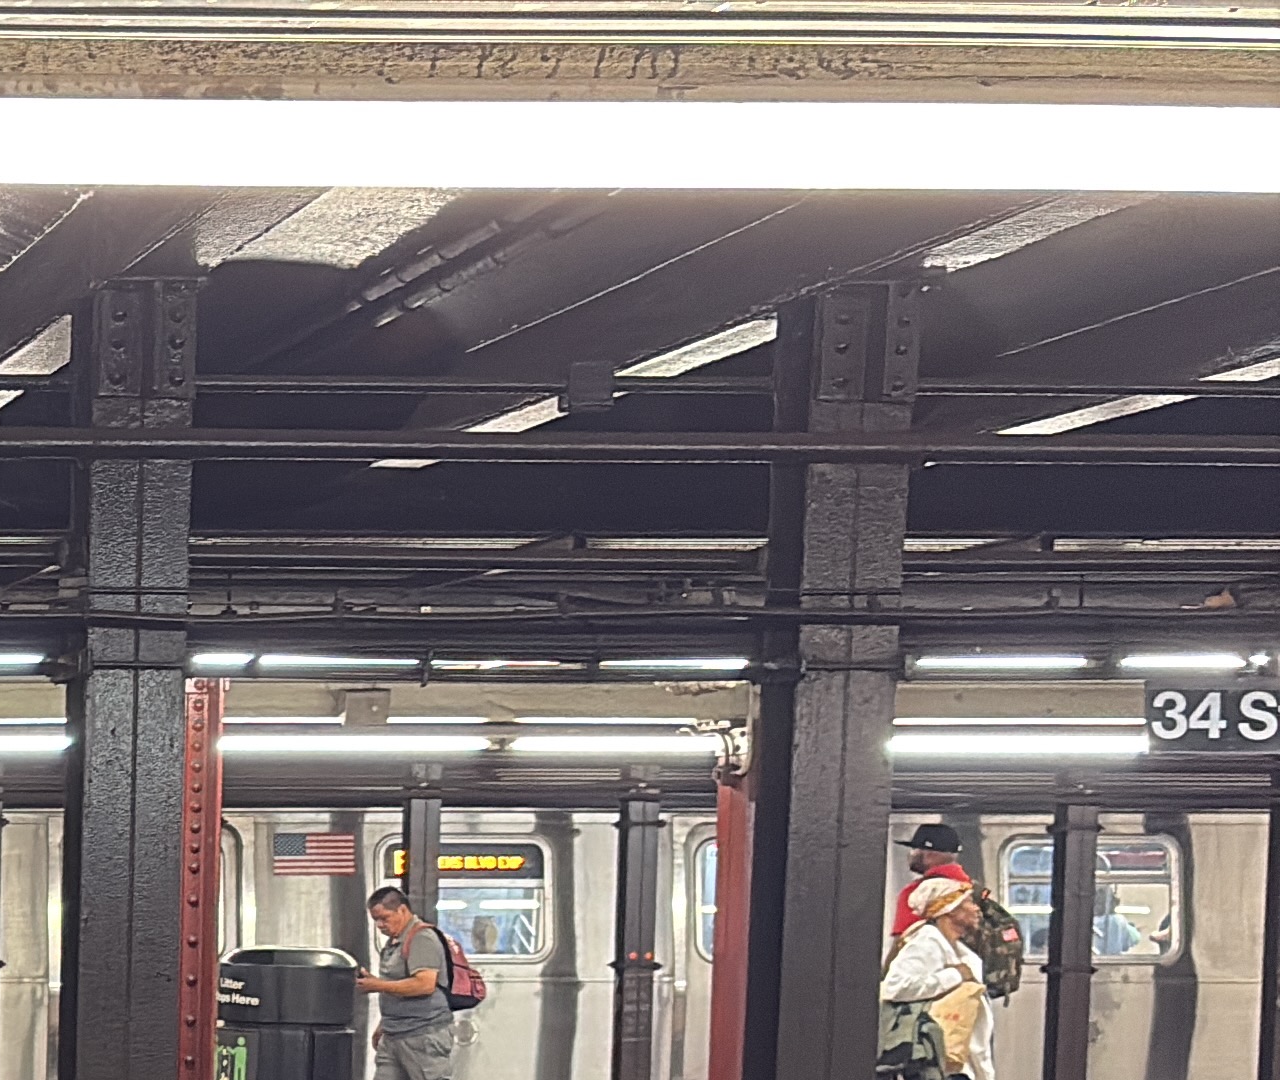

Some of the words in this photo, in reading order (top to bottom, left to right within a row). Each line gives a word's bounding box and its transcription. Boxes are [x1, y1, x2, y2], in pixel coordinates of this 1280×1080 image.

[1151, 690, 1227, 740] 34
[1237, 690, 1280, 741] S
[231, 991, 259, 1006] Here
